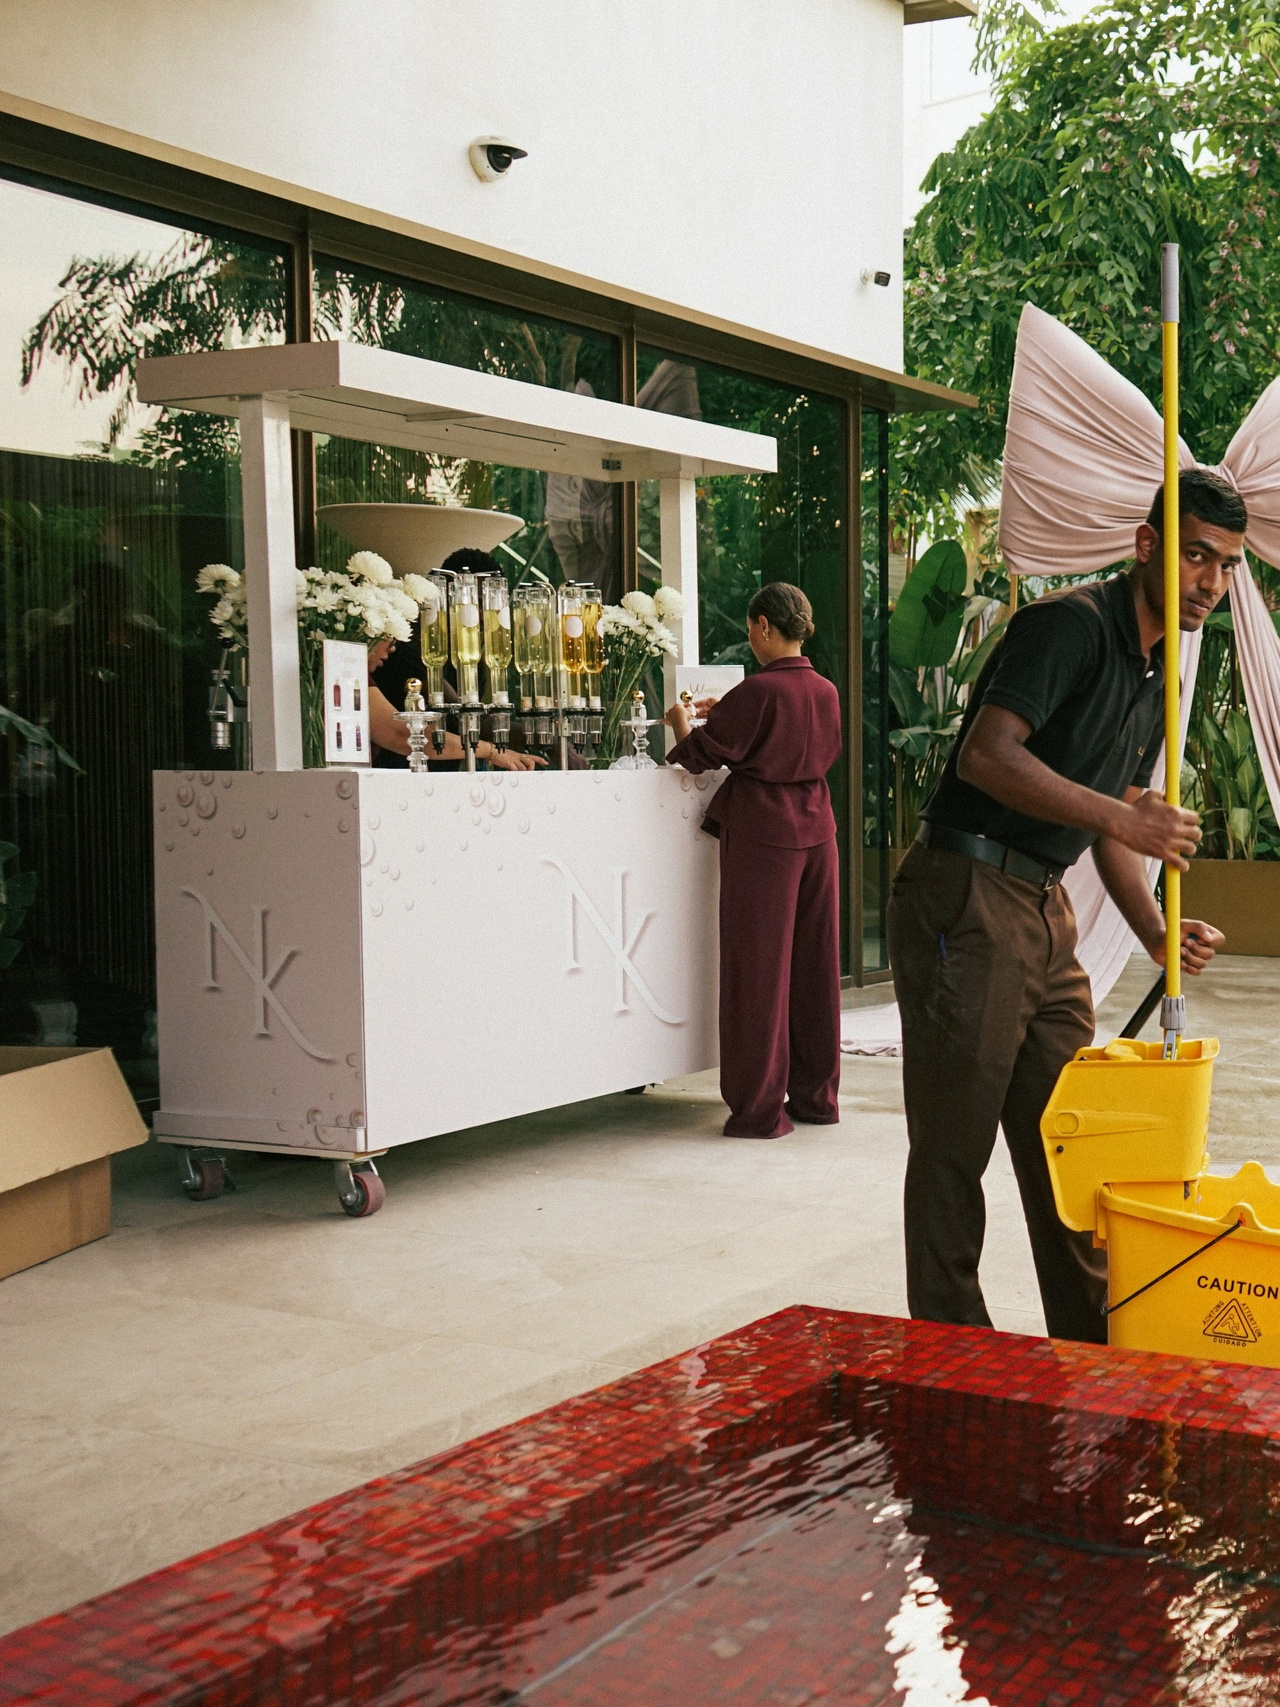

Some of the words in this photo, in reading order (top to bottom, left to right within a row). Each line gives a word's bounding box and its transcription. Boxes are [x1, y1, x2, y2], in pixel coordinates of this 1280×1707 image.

[1196, 1275, 1279, 1300] CAUTION
[1202, 1300, 1225, 1326] ACHTUNG
[1241, 1302, 1263, 1338] ATTENTION
[1213, 1337, 1247, 1348] CUIDADO
